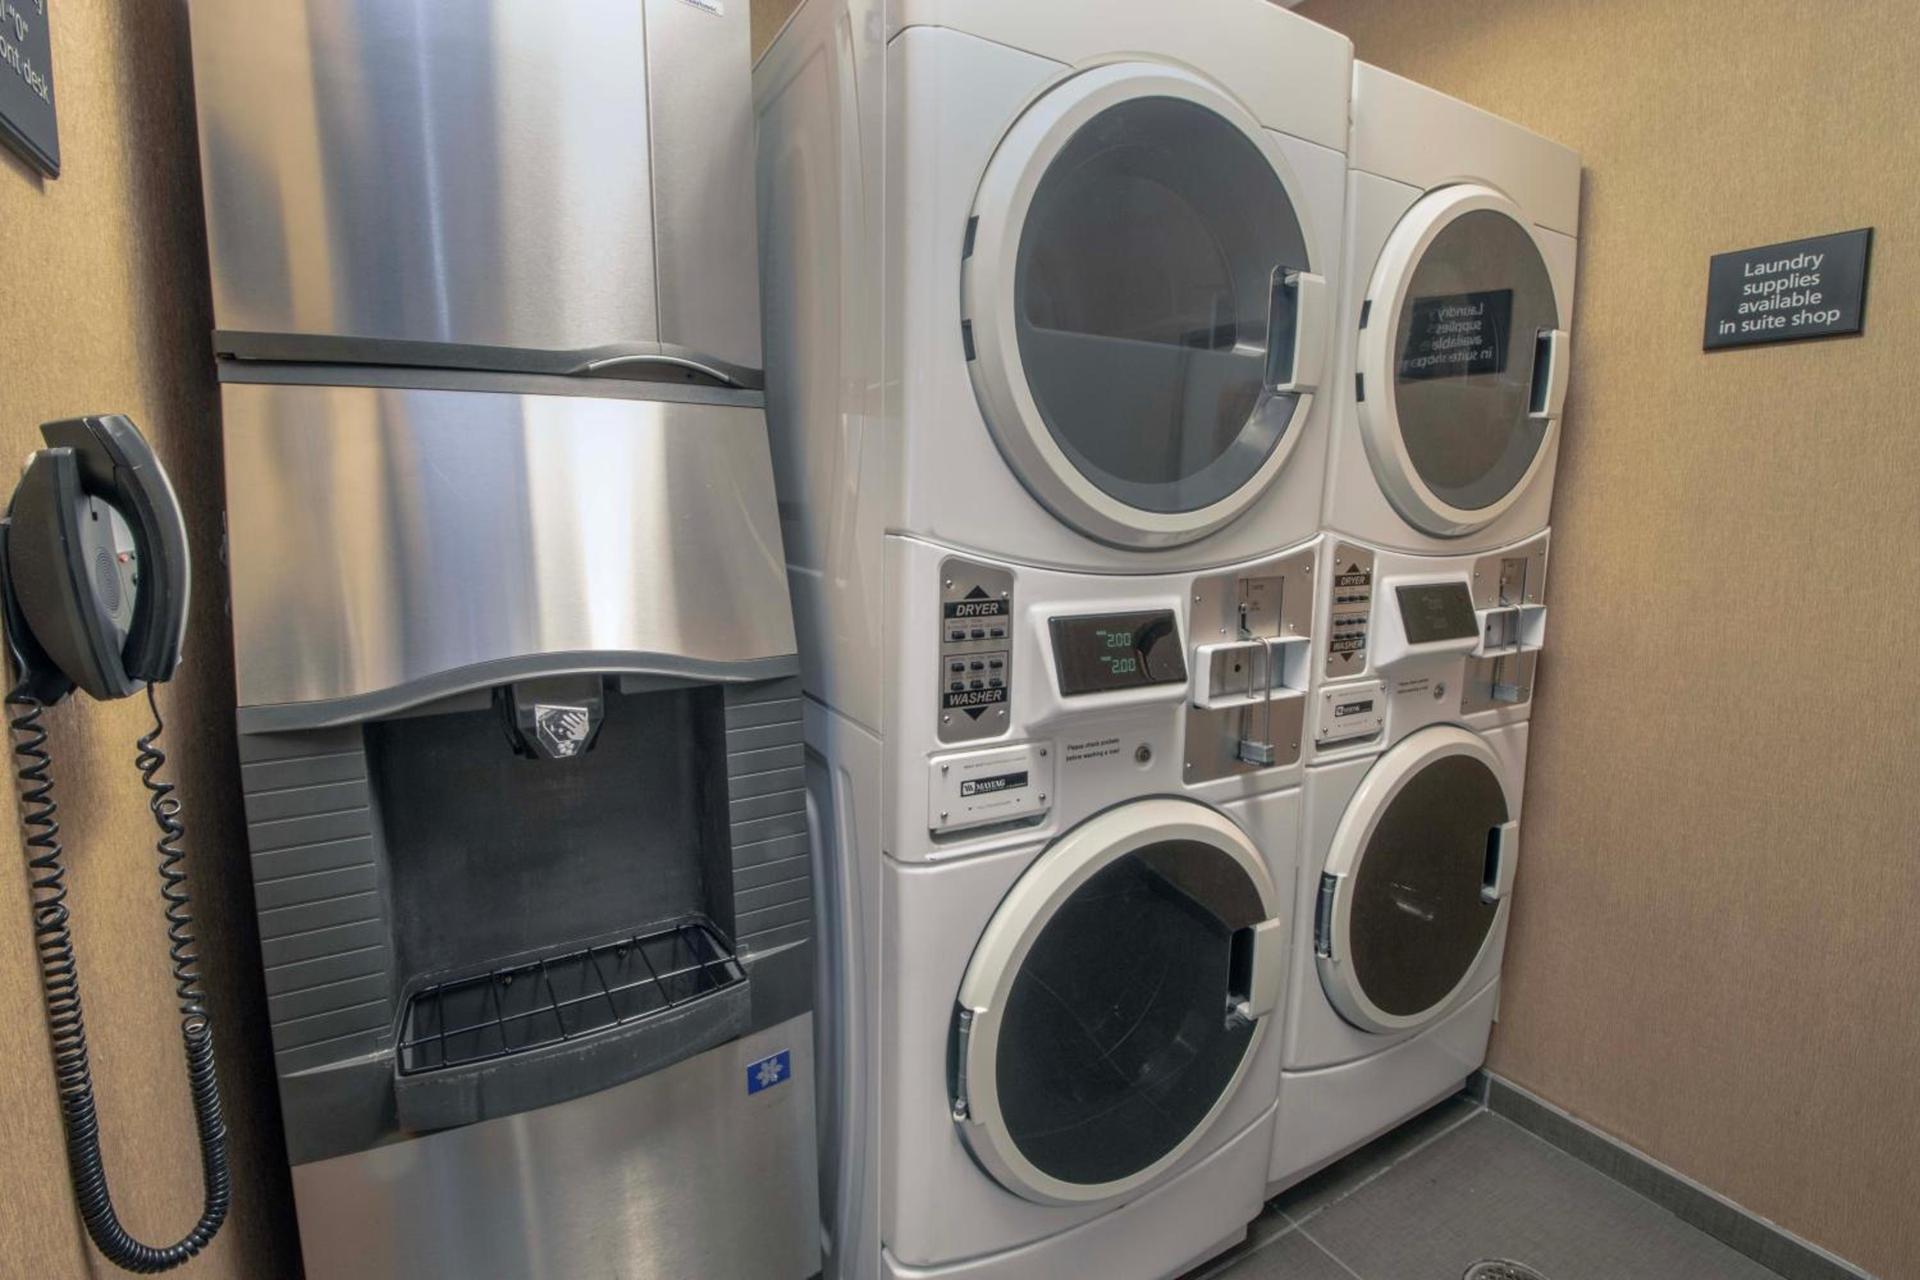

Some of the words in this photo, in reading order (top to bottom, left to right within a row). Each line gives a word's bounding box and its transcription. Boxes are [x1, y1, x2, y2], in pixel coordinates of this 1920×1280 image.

[24, 59, 50, 105] desk
[1743, 252, 1824, 278] Laundry
[1743, 272, 1821, 297] supplies
[1738, 290, 1823, 315] available
[1719, 320, 1736, 336] in
[1741, 314, 1787, 332] suite
[1791, 308, 1841, 327] shop
[1341, 575, 1366, 586] DRYER
[956, 602, 999, 616] DRYER
[949, 690, 1002, 706] WASHER
